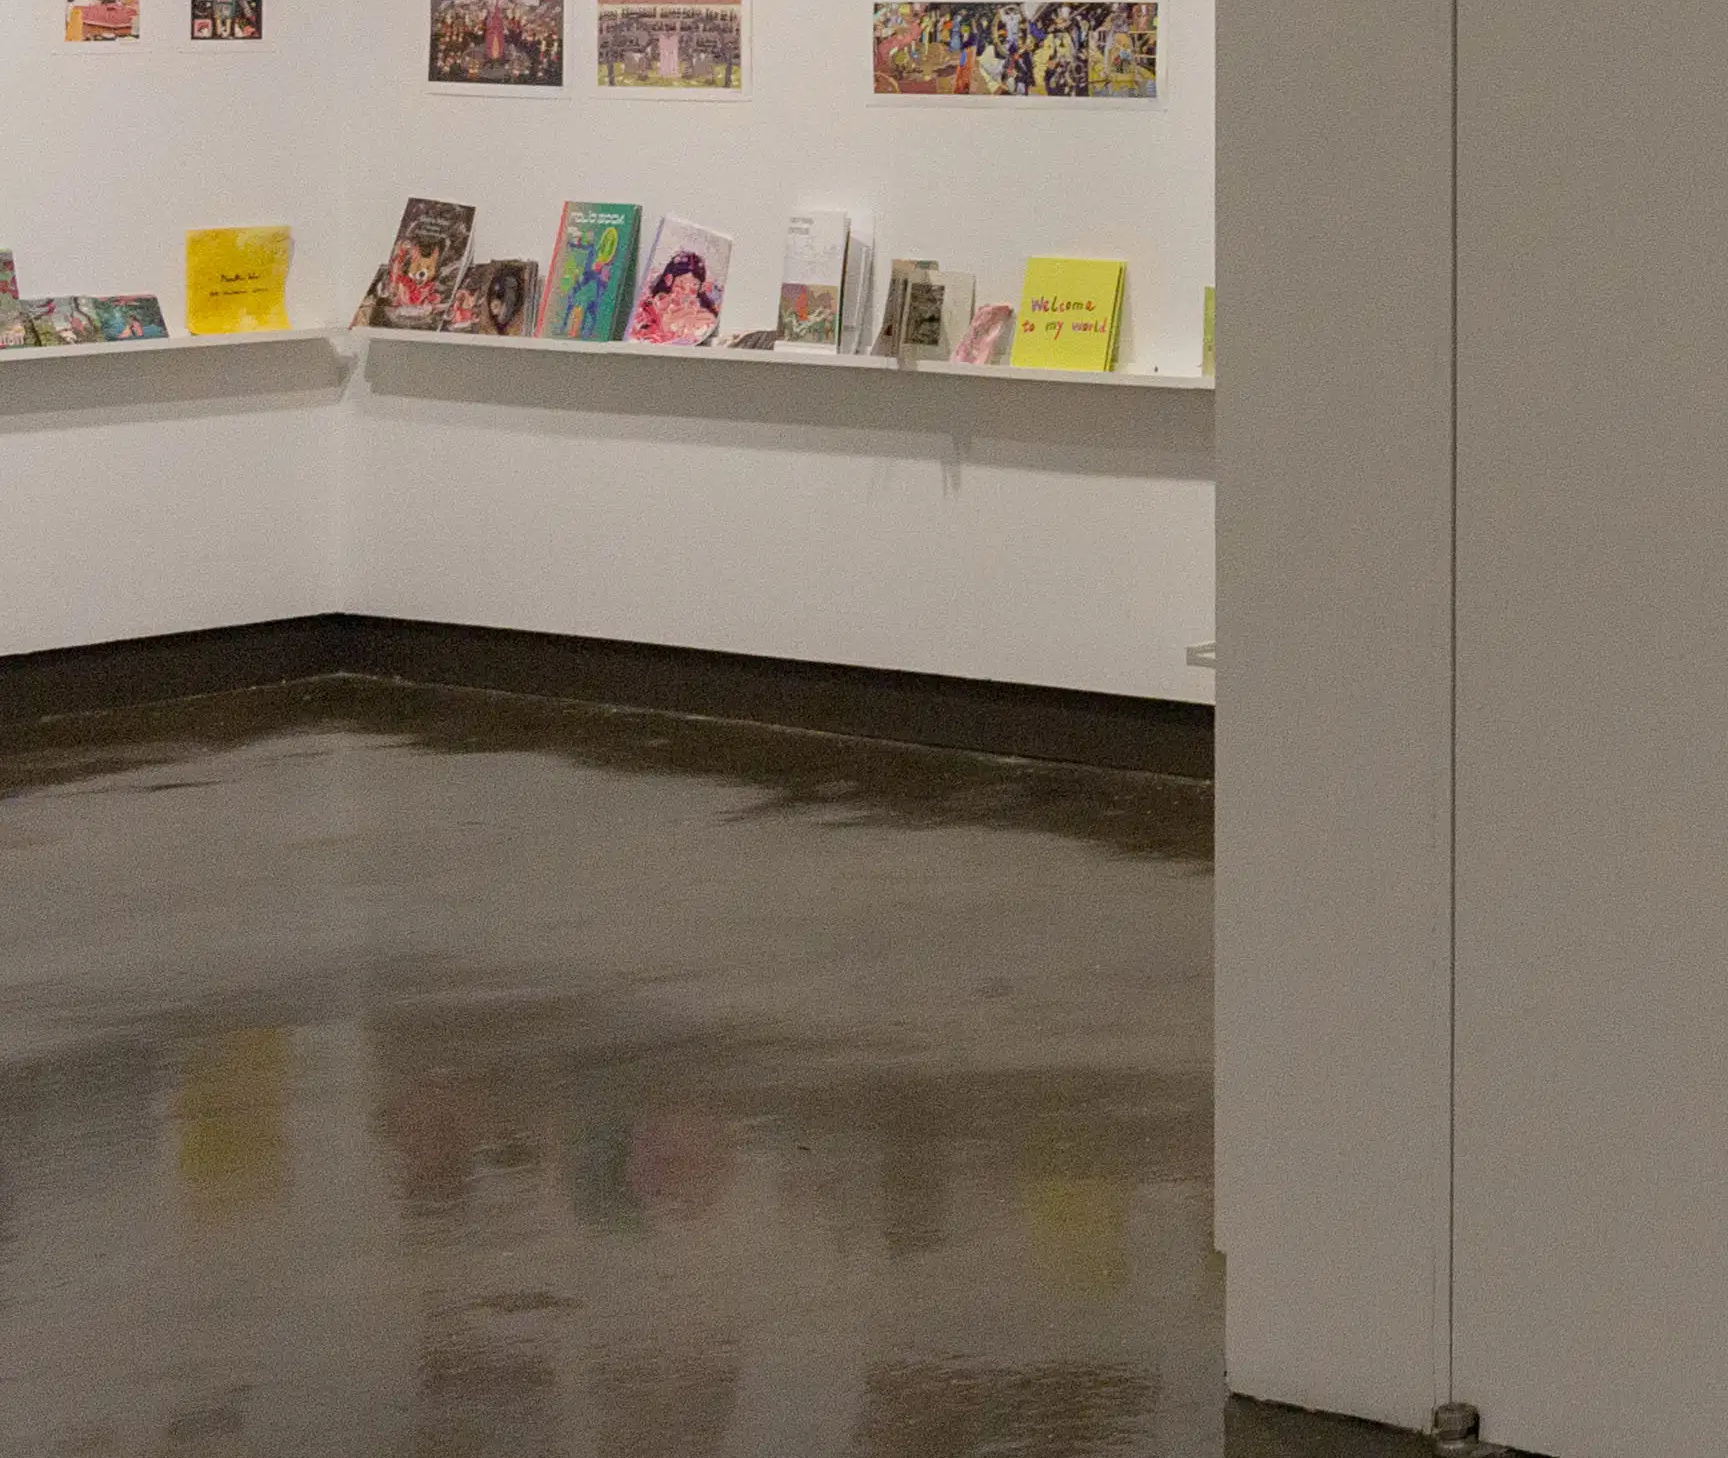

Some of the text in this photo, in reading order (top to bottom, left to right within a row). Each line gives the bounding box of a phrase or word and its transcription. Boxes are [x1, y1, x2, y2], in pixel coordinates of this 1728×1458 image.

[1031, 295, 1096, 313] Welcome
[1021, 317, 1108, 341] to my world
